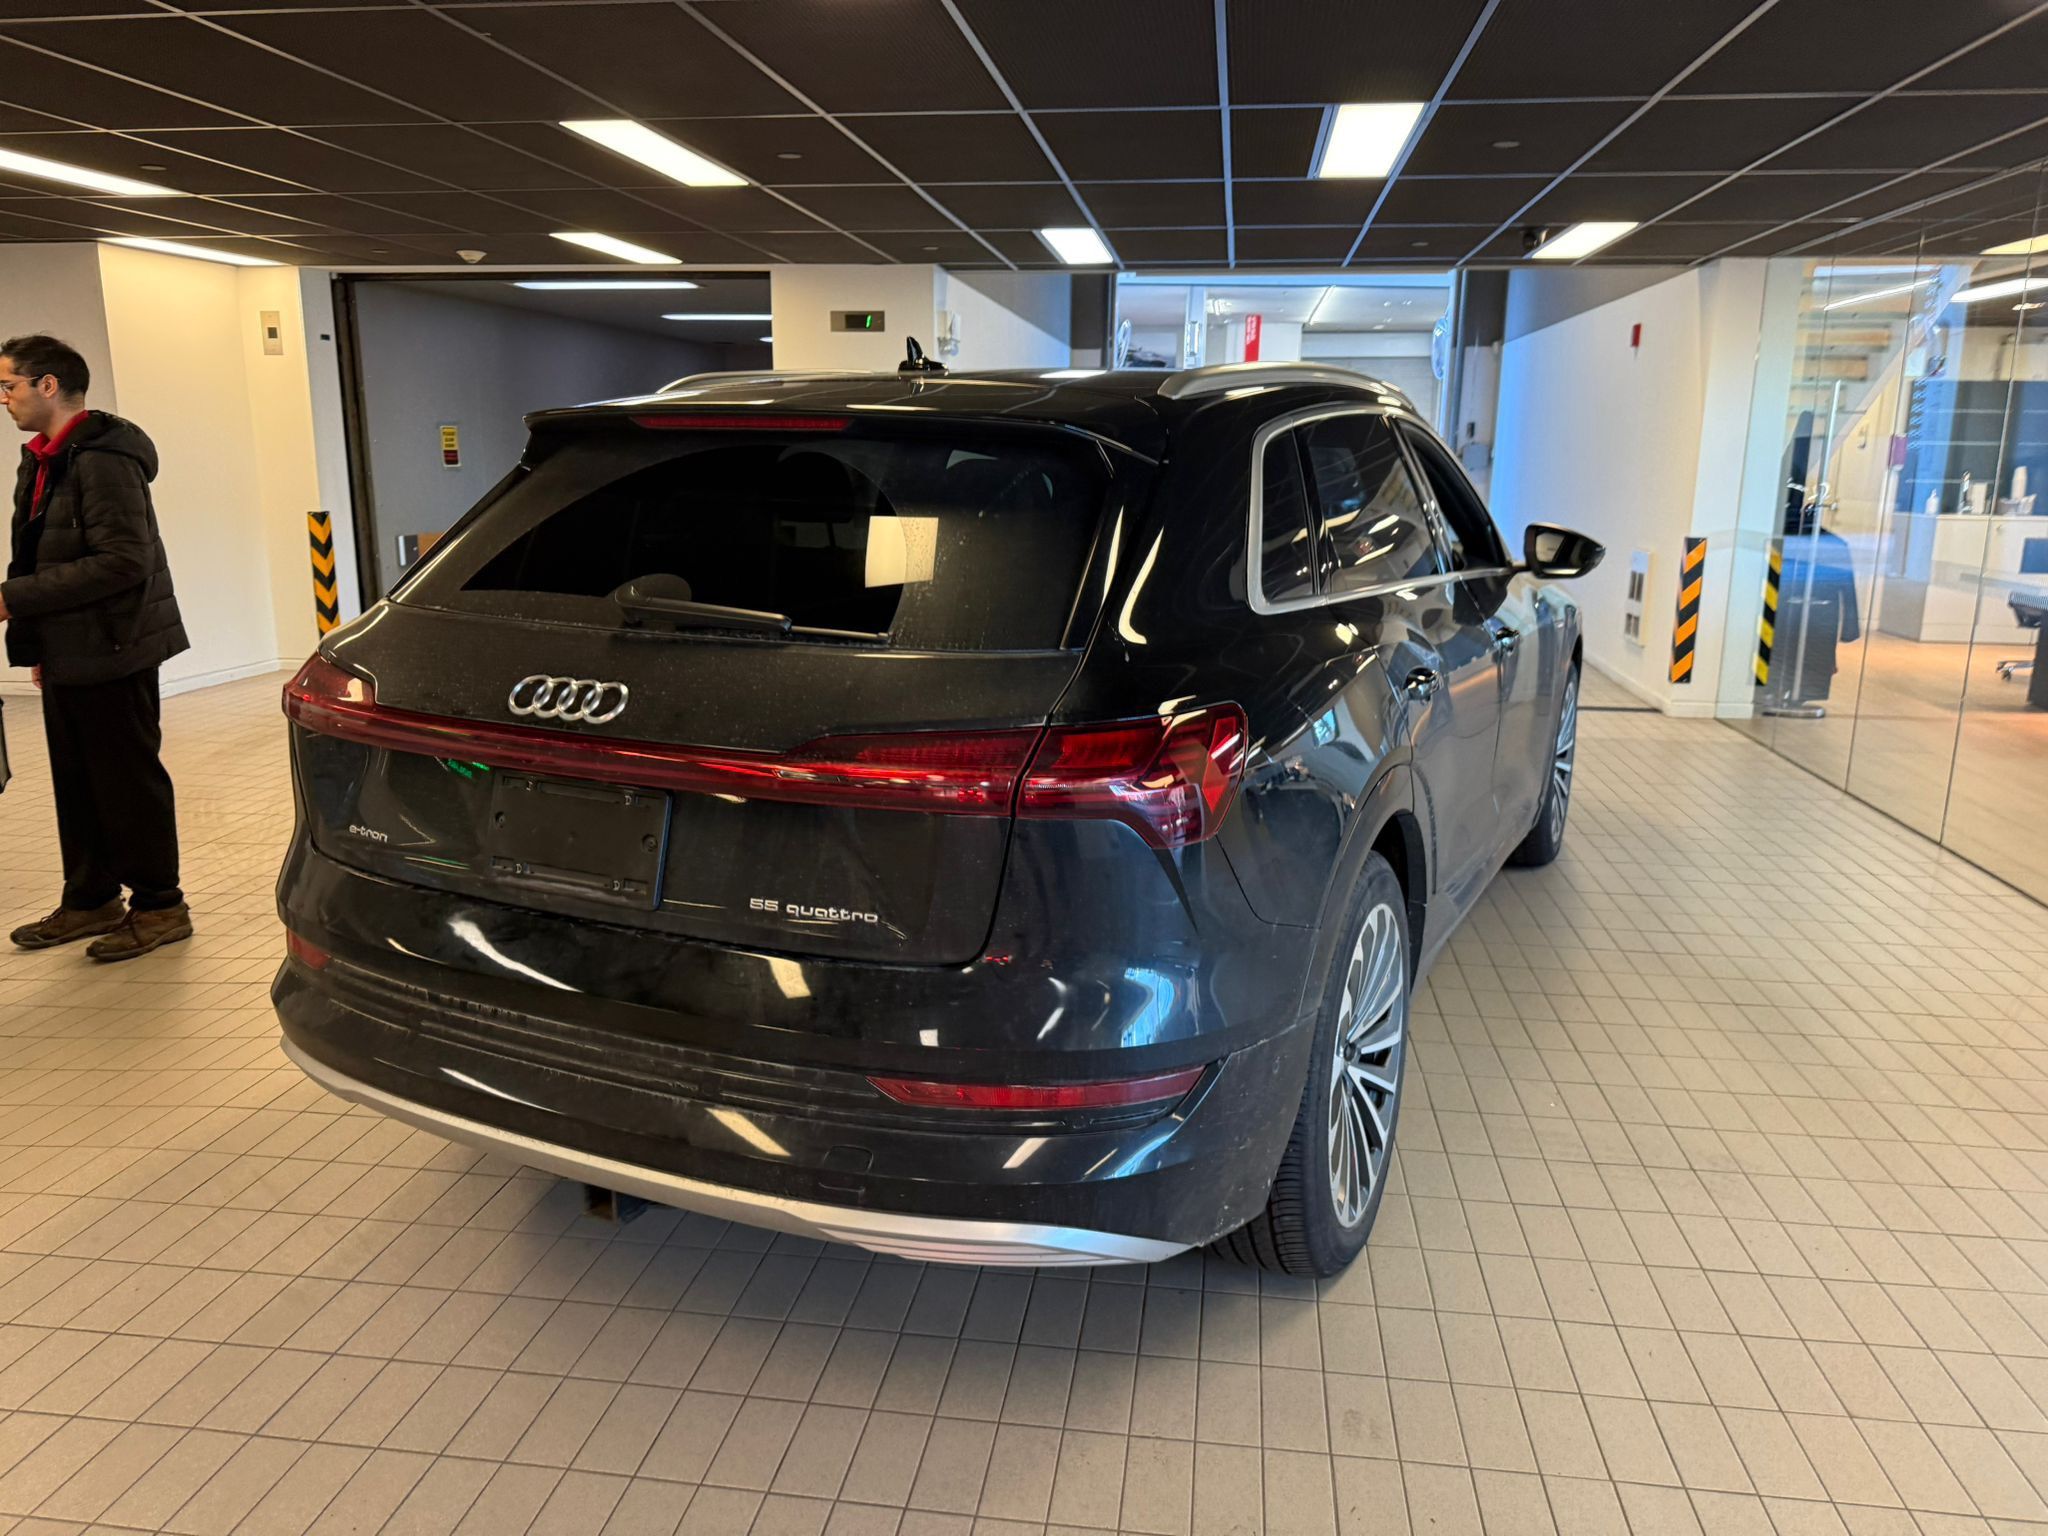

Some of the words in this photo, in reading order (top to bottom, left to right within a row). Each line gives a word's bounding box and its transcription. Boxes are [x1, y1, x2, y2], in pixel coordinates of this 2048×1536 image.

[349, 825, 388, 843] e-tron
[749, 898, 779, 912] 55
[786, 904, 878, 923] quattro
